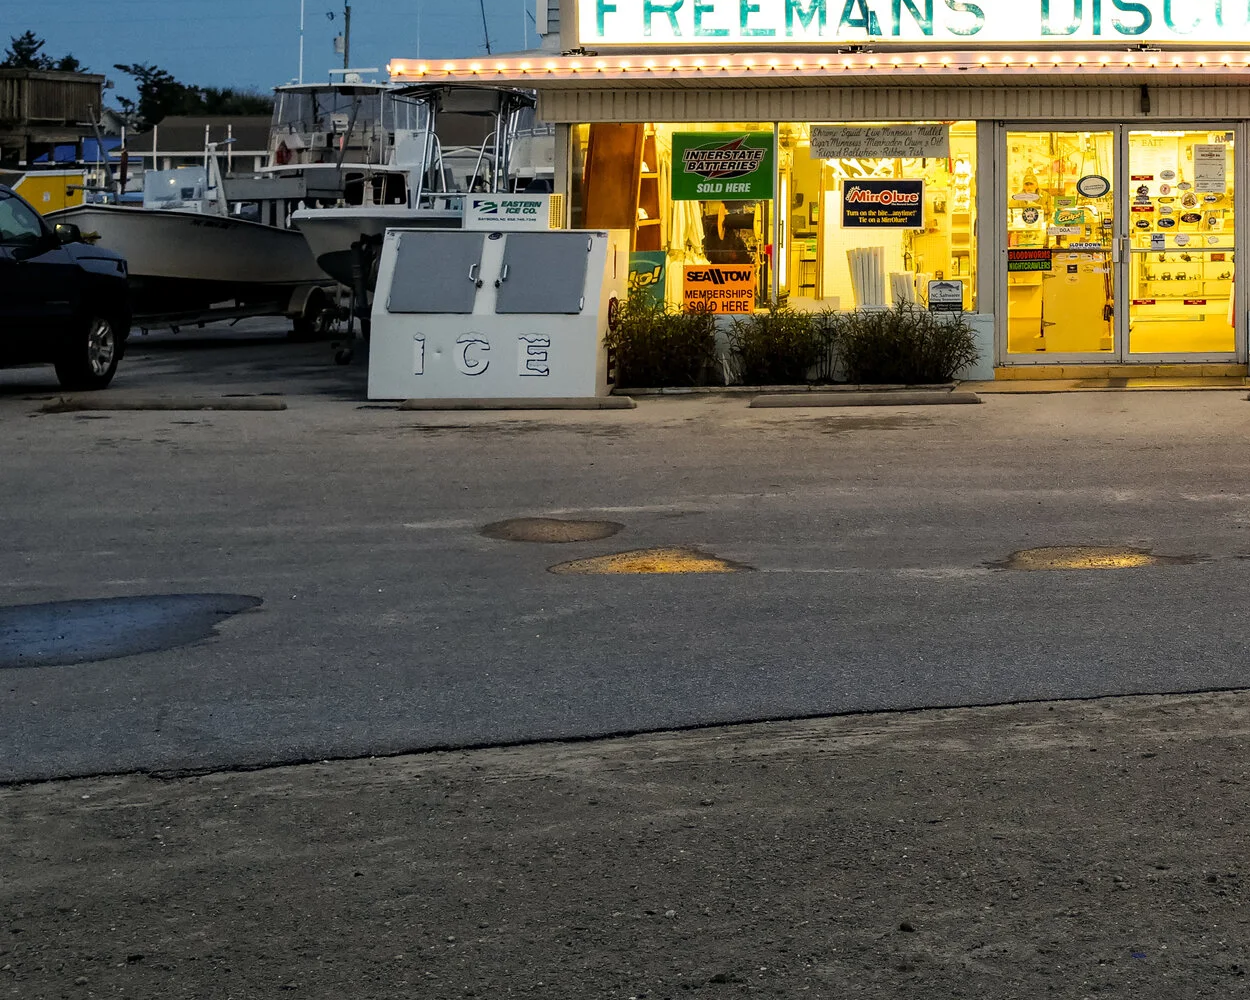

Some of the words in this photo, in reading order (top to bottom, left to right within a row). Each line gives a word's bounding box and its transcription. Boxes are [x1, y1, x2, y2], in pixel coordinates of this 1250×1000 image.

[685, 149, 764, 160] INTERSTATE
[687, 160, 757, 171] BATTERIES
[696, 182, 723, 193] SOLD
[725, 182, 752, 193] HERE
[501, 200, 542, 208] EASTERN
[1008, 250, 1051, 260] BLOODWORMS
[1008, 260, 1051, 270] NIGHTCRAWLERS
[686, 270, 711, 282] SEA
[721, 270, 752, 282] TOW
[684, 289, 753, 299] MEMBERSHIPS
[689, 300, 718, 312] SOLD
[721, 300, 749, 312] HERE
[413, 332, 551, 377] ICE
